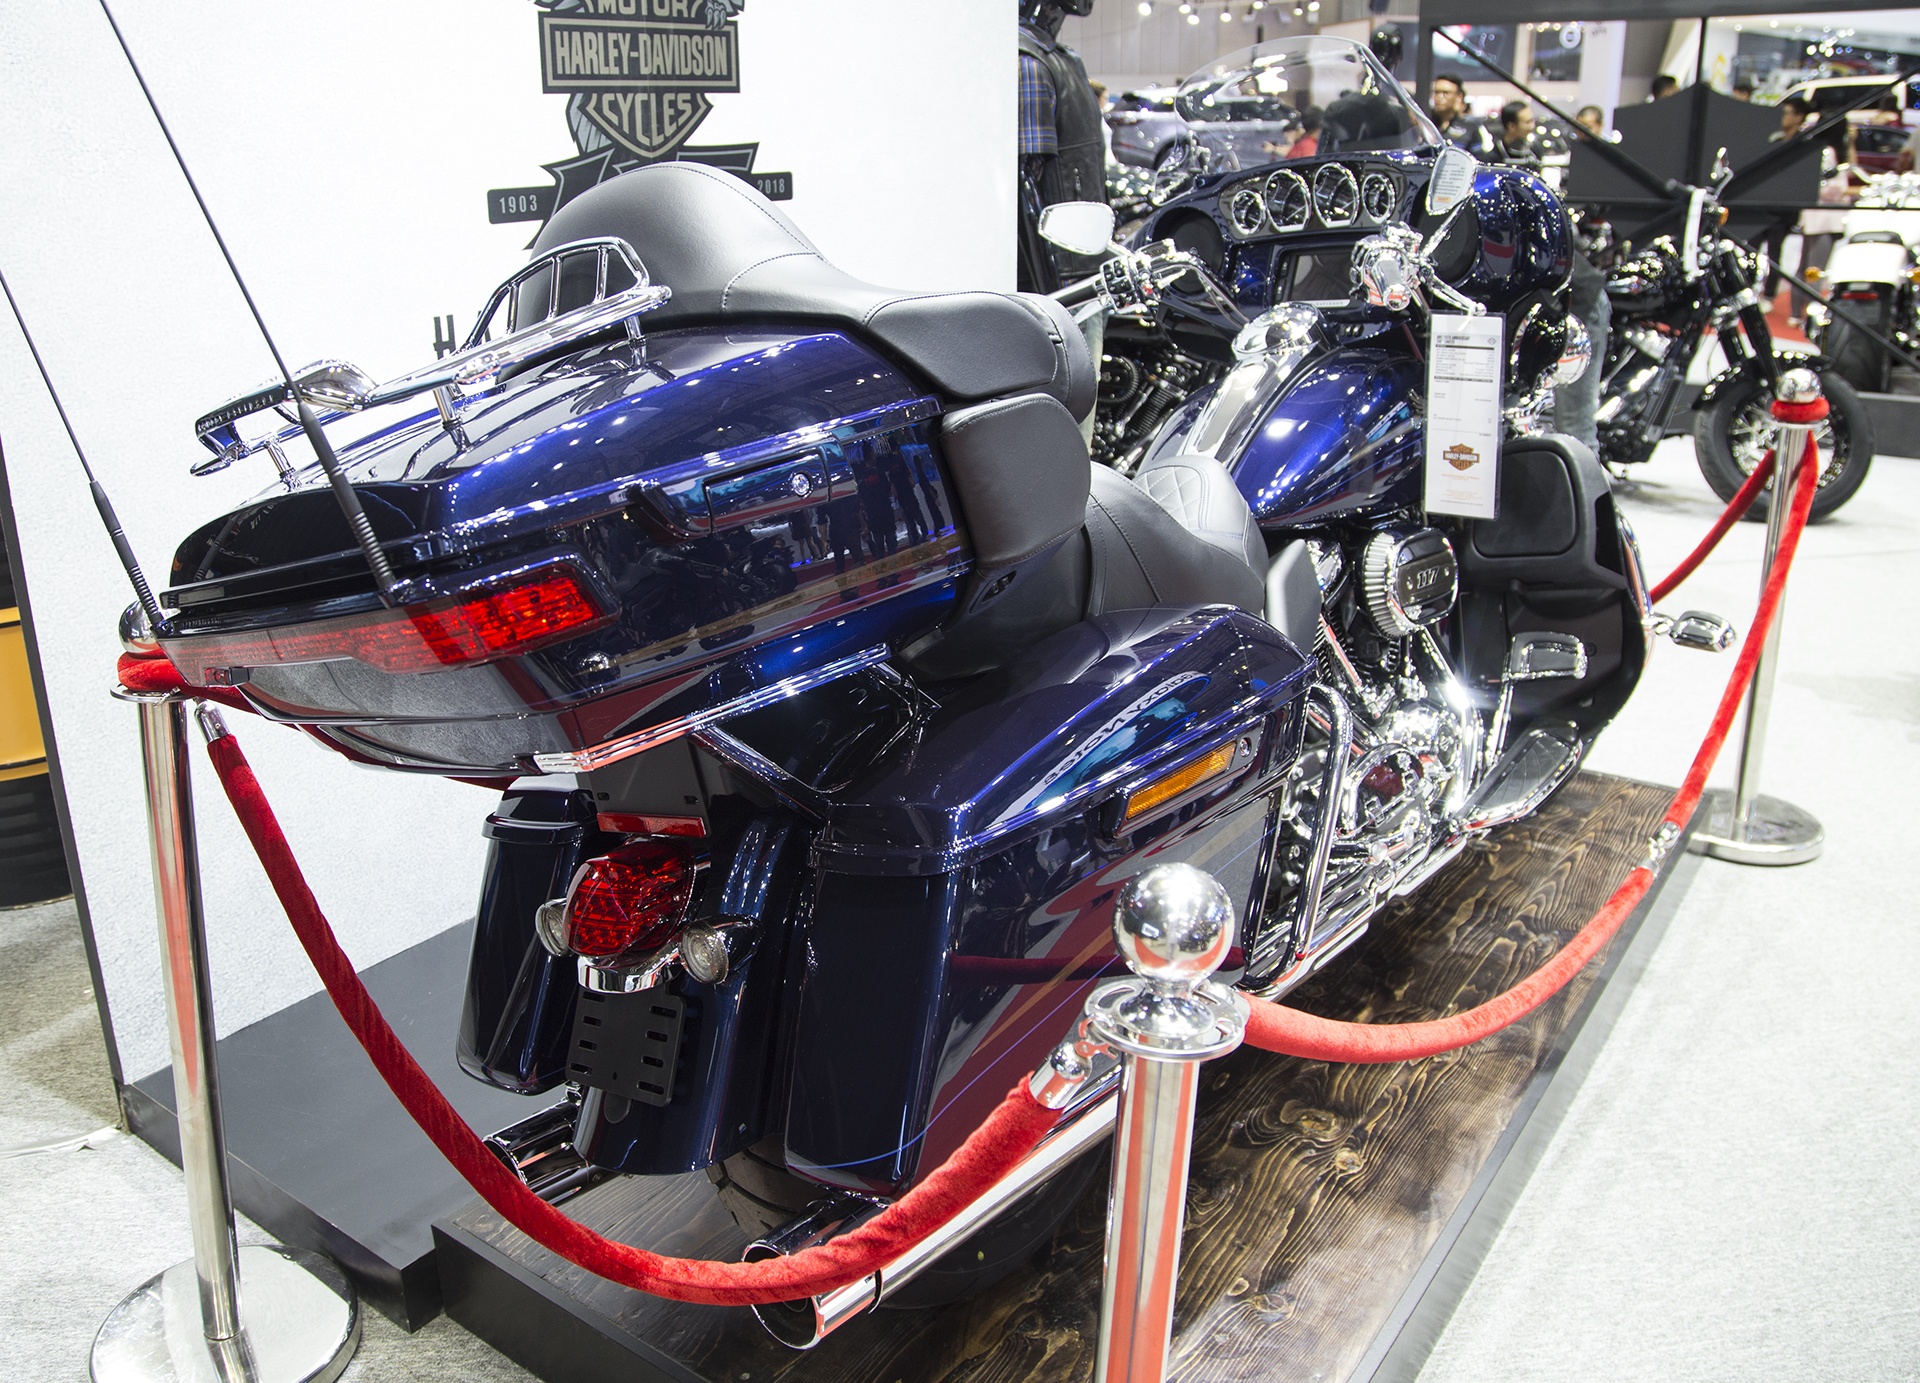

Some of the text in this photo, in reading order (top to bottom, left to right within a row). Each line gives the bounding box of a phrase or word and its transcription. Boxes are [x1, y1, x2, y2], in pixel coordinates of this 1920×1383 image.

[554, 30, 728, 76] HARLEY-DAVIDSON
[601, 92, 693, 147] CYCLES
[757, 178, 785, 194] 2018
[499, 194, 538, 214] 1903
[1417, 566, 1440, 589] 117
